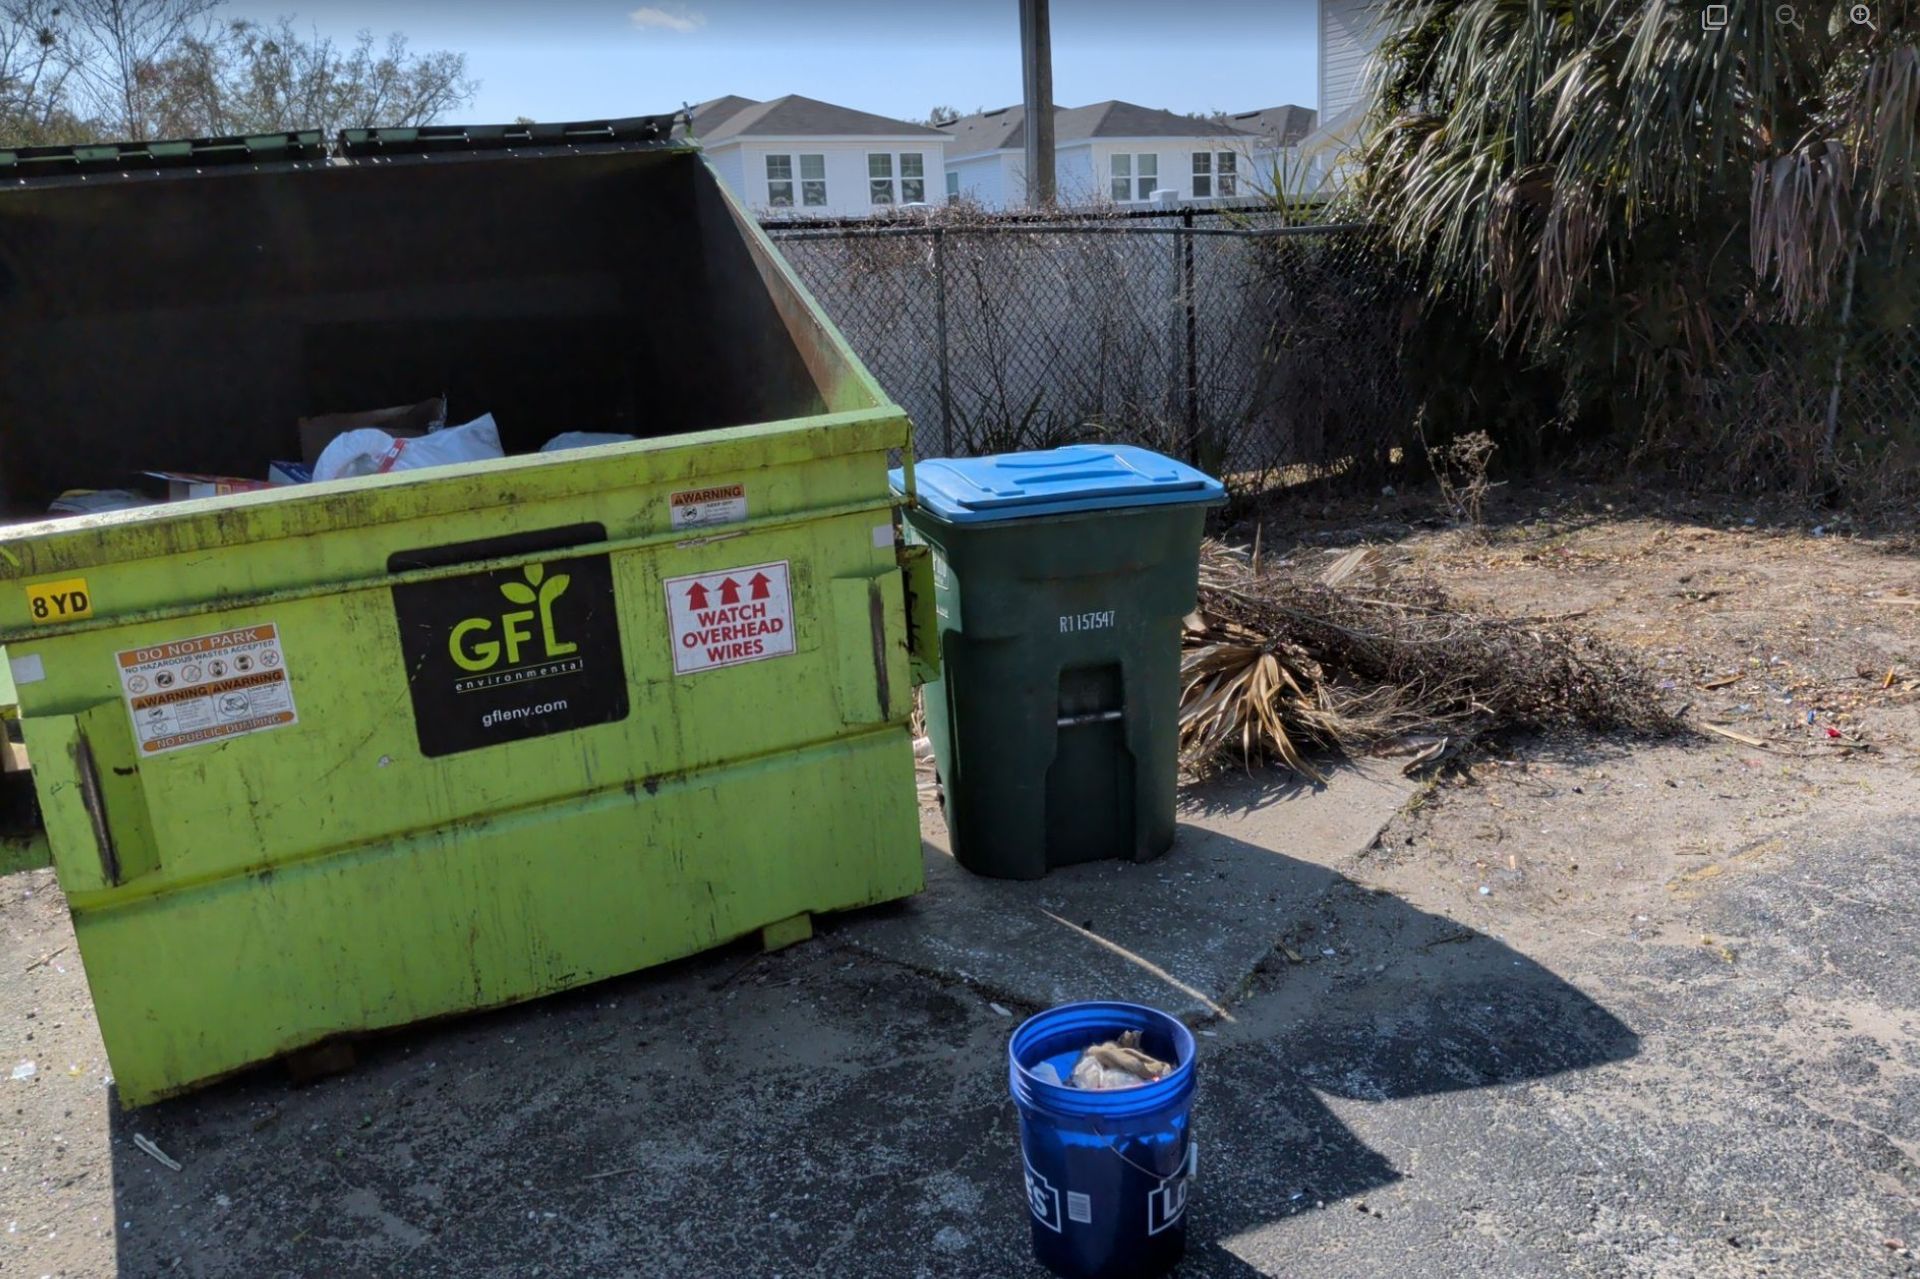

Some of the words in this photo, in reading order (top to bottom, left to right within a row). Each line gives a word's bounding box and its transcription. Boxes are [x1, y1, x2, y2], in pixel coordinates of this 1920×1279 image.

[683, 486, 741, 503] WARNING
[32, 591, 88, 618] 8YD
[697, 602, 766, 628] WATCH
[448, 574, 577, 671] GFL
[682, 618, 783, 648] OVERHEAD
[137, 648, 162, 662] DO
[168, 640, 204, 657] NOT
[210, 629, 258, 648] PARK
[140, 656, 193, 670] HAZARDOUS
[194, 648, 228, 660] WASTES
[231, 640, 274, 654] ACCEPTED
[707, 639, 764, 662] WIRES
[219, 671, 283, 691] WARNING
[455, 659, 584, 691] environmental
[144, 686, 208, 706] WARNING
[482, 699, 568, 727] gflenv.com
[157, 738, 175, 748] NO
[178, 728, 223, 743] PUBLIC
[226, 714, 280, 732] DUMPING
